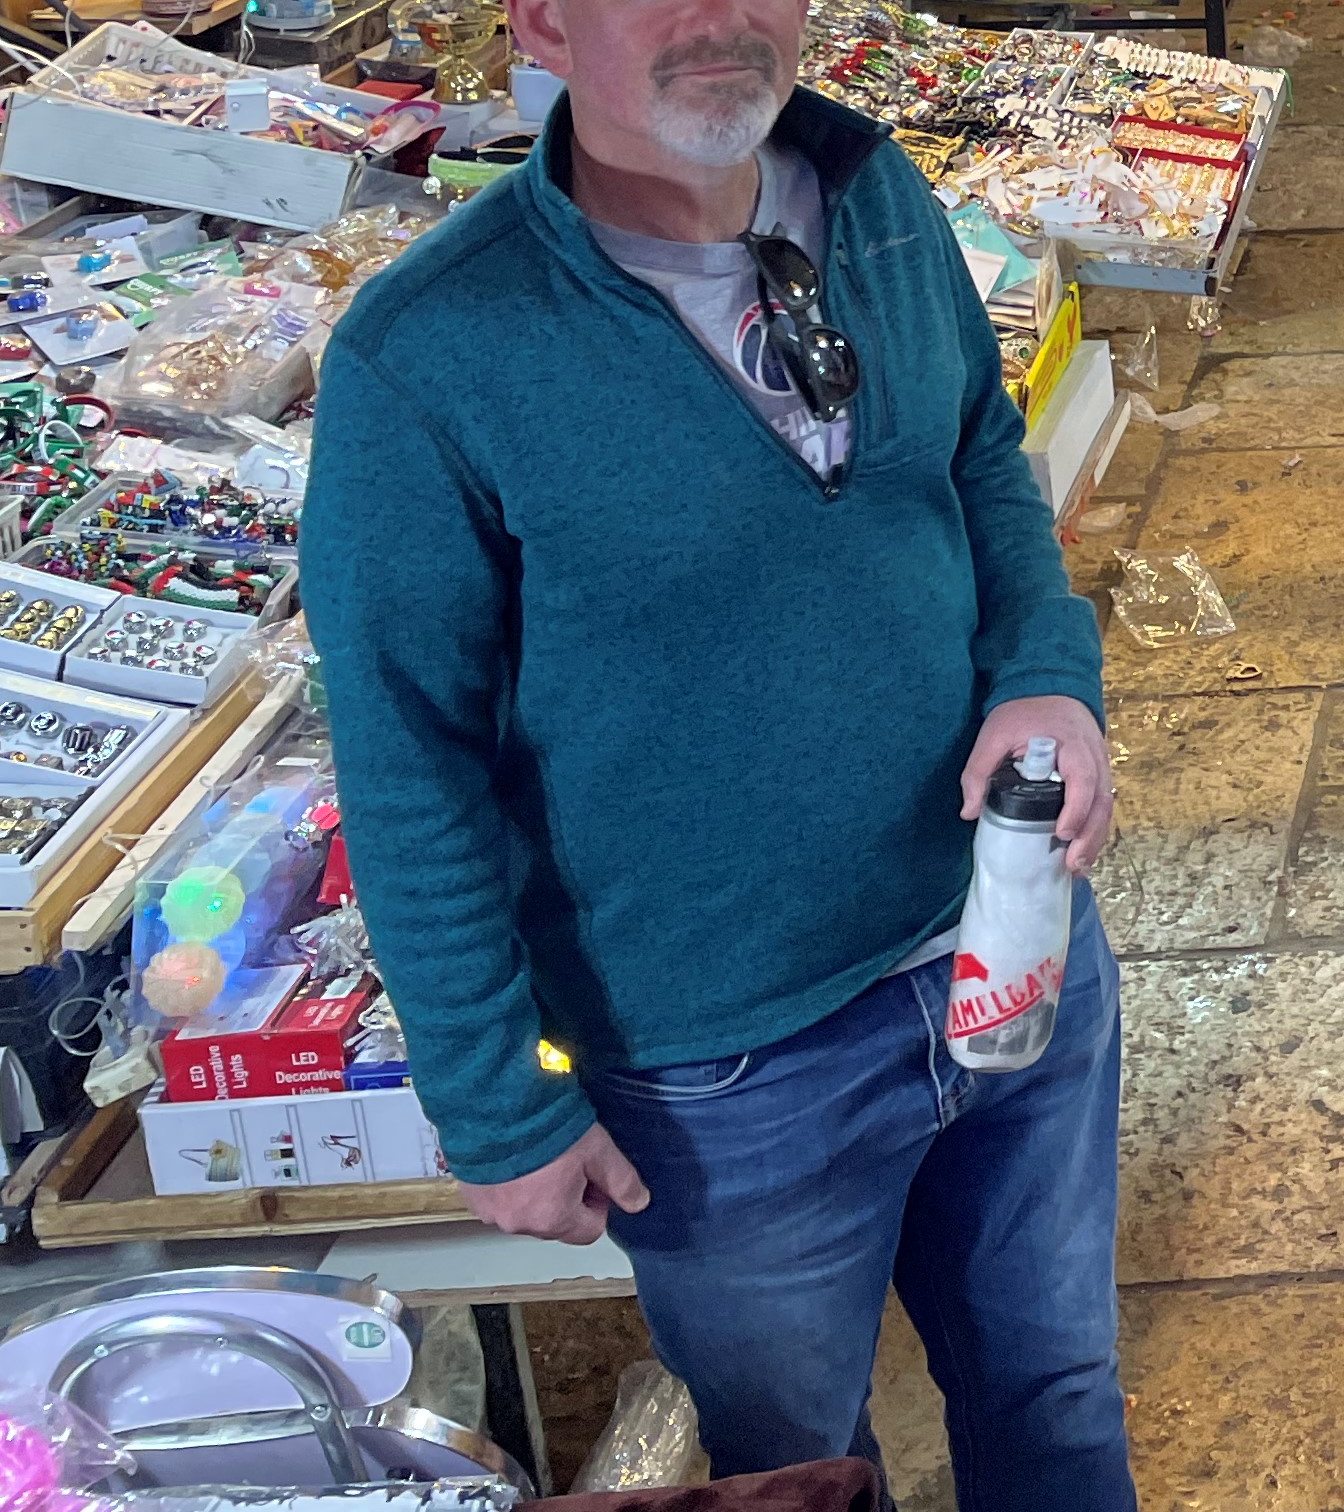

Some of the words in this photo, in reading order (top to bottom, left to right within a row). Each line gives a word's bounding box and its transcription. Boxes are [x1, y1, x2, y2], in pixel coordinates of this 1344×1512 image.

[291, 1051, 319, 1066] LED
[190, 1065, 207, 1089] LED
[209, 1045, 229, 1101] Decorative
[230, 1054, 249, 1089] Lights
[275, 1068, 341, 1084] Decorative
